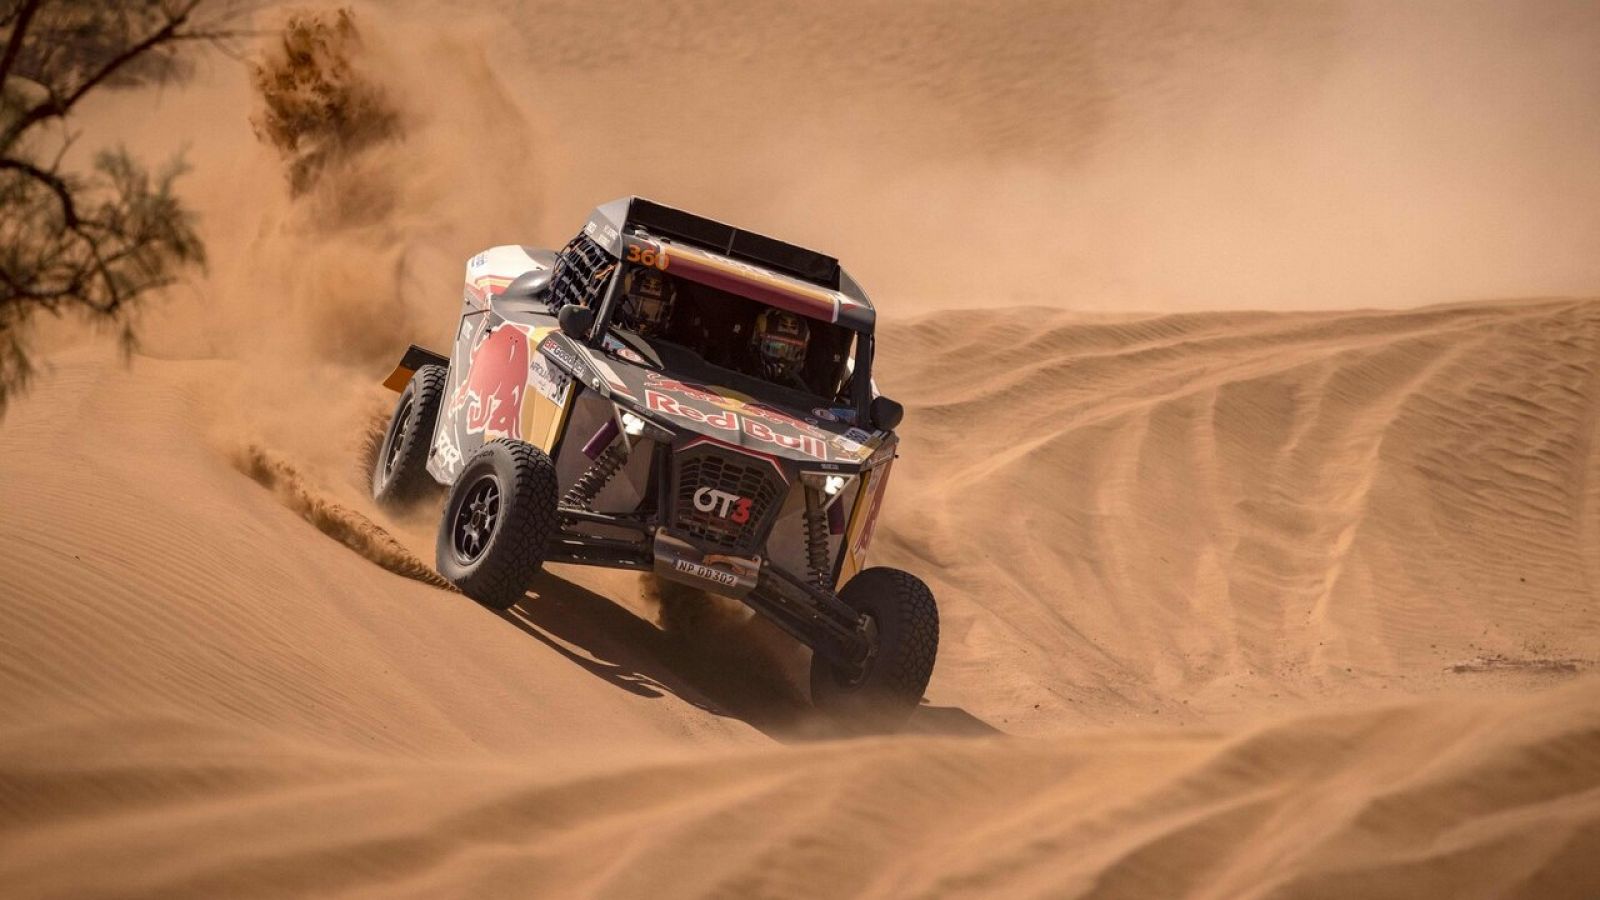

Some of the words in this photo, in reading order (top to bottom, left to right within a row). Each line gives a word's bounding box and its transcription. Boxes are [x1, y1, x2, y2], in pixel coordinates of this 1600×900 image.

[626, 244, 670, 272] 360
[645, 389, 739, 431] Red
[741, 413, 827, 461] Bull
